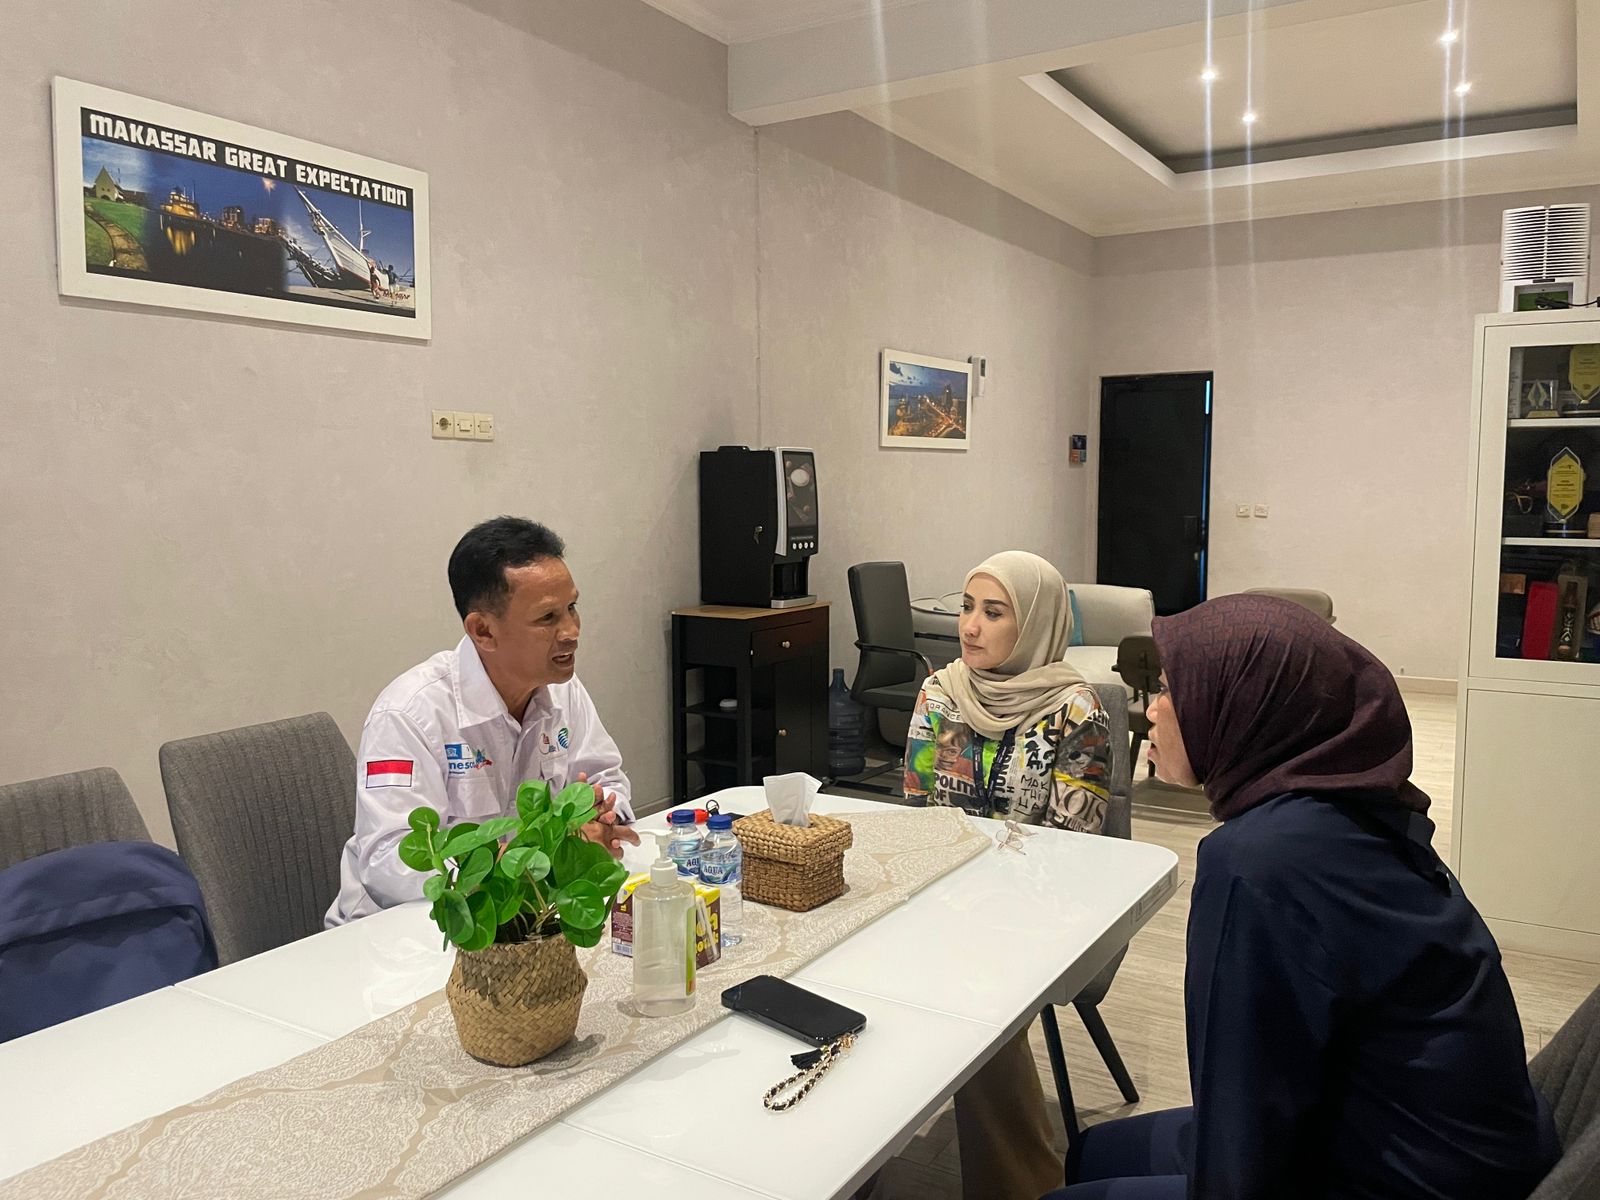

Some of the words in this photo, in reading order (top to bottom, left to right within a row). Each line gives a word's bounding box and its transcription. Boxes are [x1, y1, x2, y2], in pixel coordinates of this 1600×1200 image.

[90, 113, 216, 162] MAKASSAR
[225, 146, 287, 178] GREAT
[296, 164, 407, 207] EXPECTATION
[703, 865, 723, 875] AQUA
